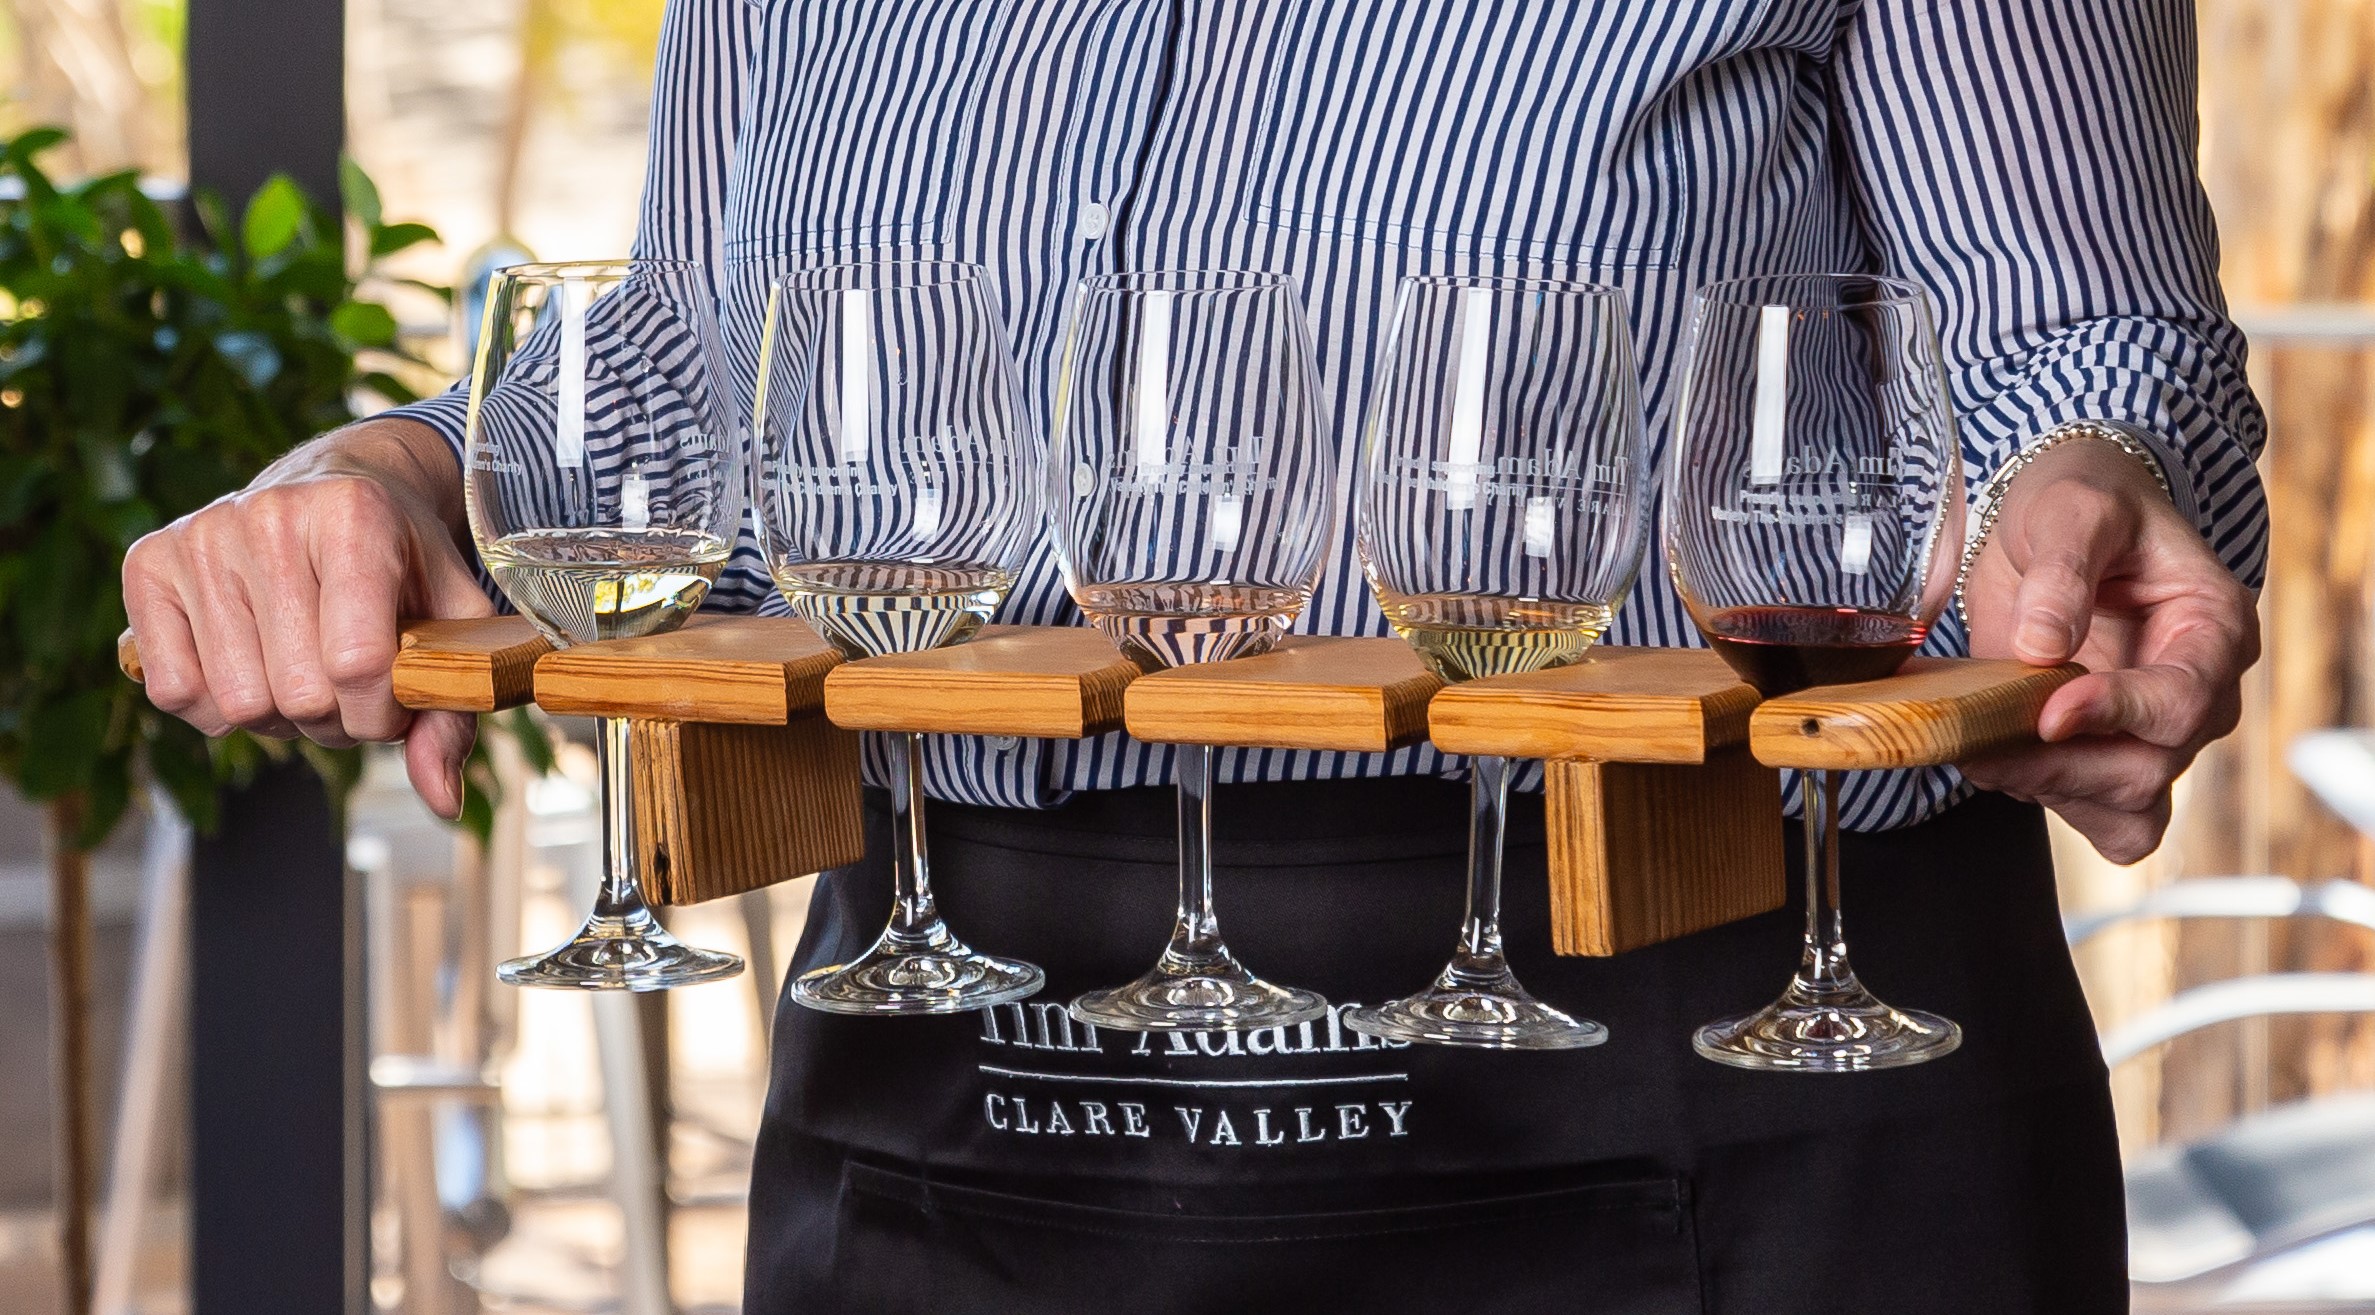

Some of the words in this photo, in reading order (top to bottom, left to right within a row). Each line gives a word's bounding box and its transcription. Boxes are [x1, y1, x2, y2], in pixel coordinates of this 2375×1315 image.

[491, 459, 522, 476] Charity
[1482, 482, 1528, 499] Charity
[984, 1093, 1151, 1138] CLARE
[1174, 1101, 1414, 1147] VALLEY
